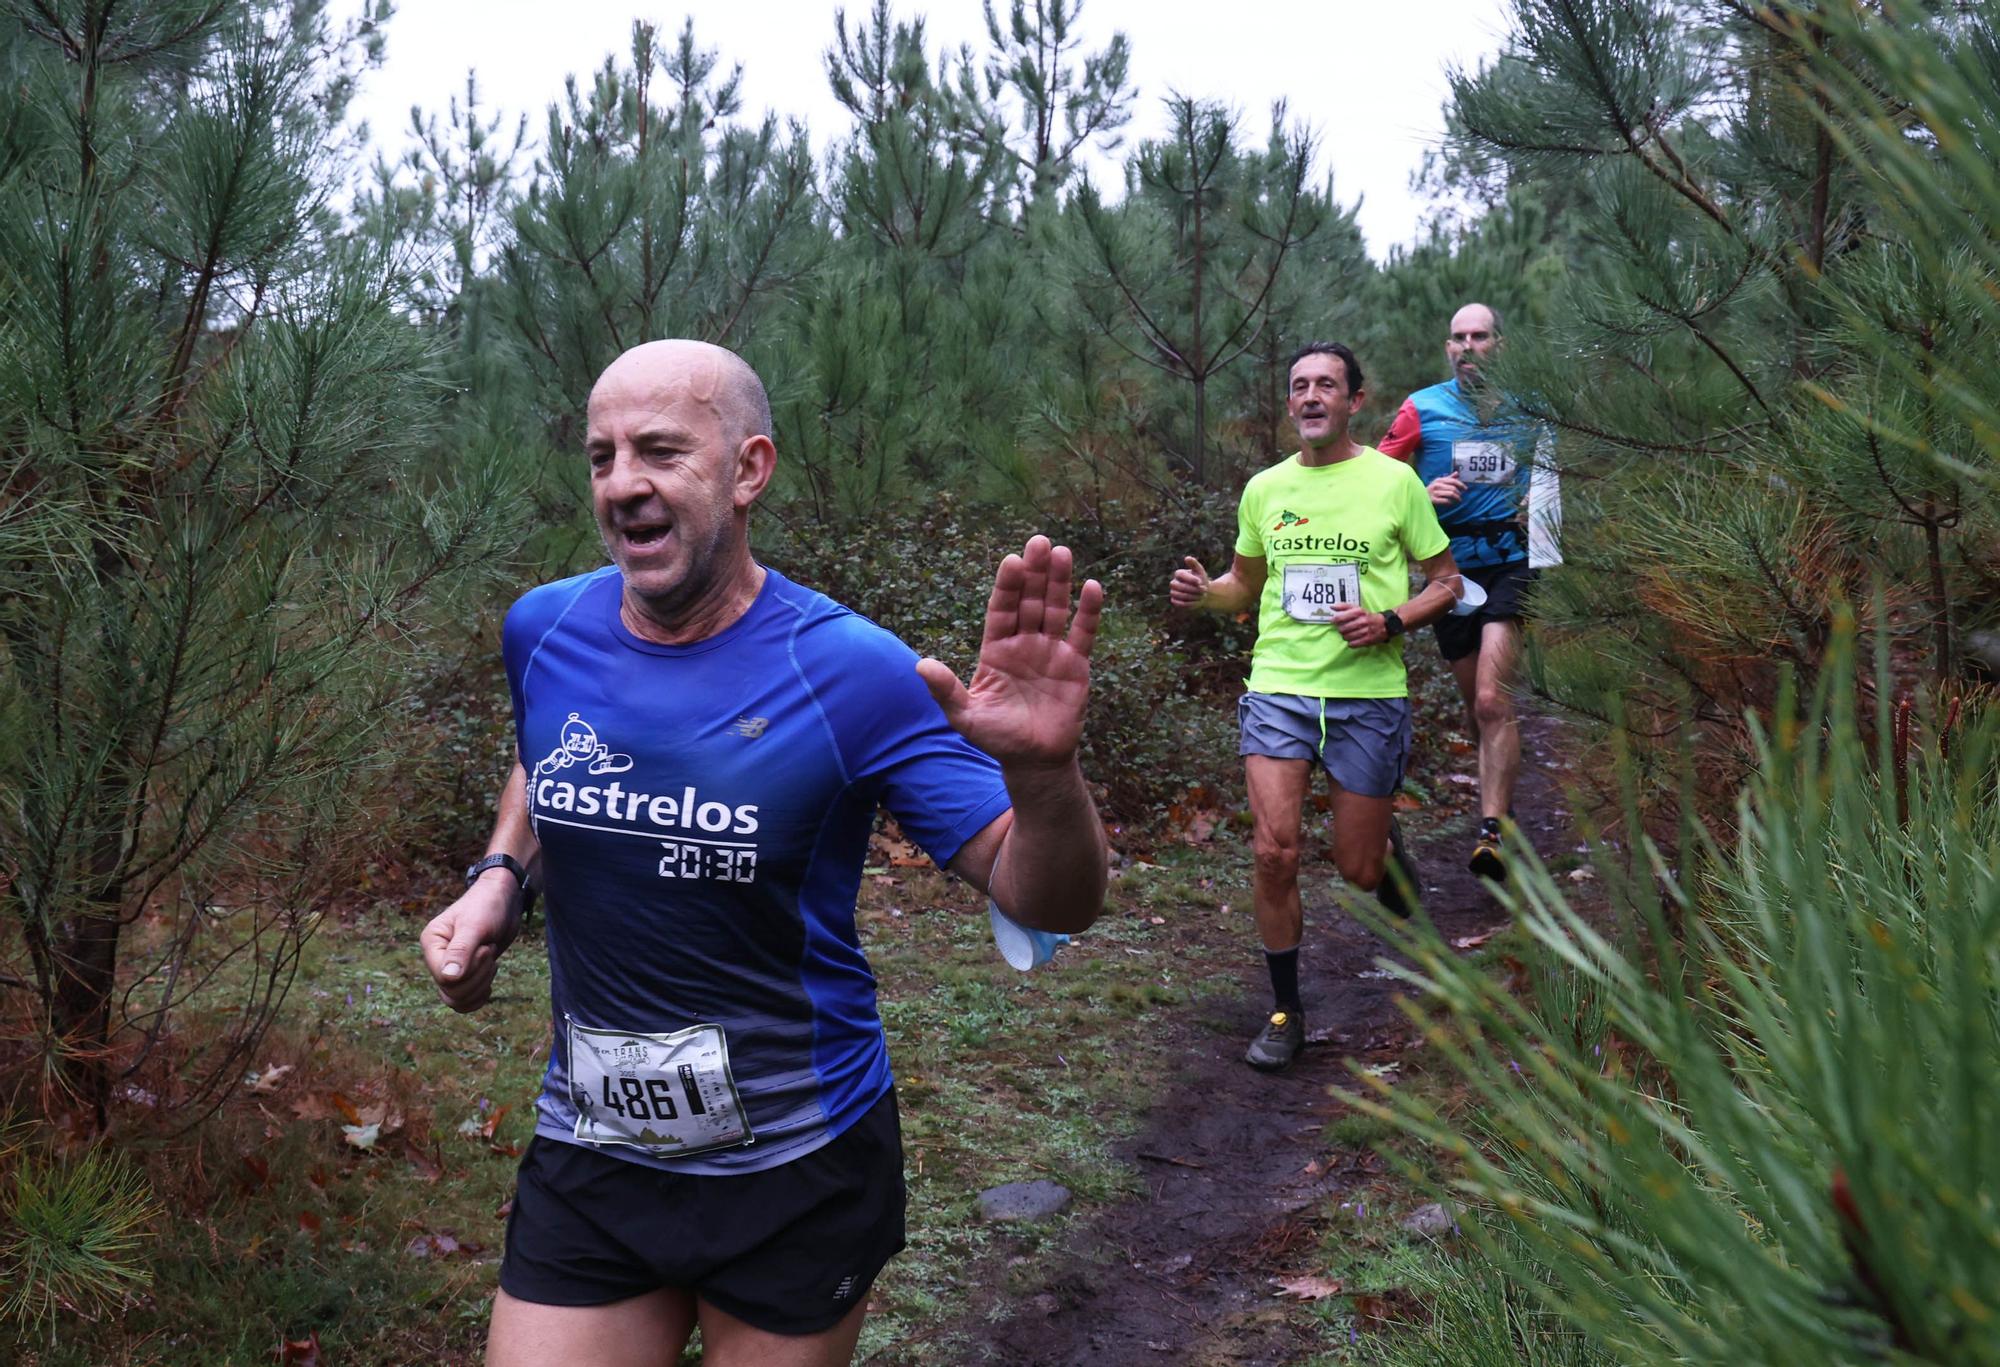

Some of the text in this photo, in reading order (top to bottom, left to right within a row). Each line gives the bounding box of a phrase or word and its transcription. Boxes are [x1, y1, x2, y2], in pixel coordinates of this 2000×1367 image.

[1469, 456, 1497, 472] 539
[1273, 533, 1370, 553] castrelos
[1302, 583, 1336, 604] 488
[536, 778, 759, 834] castrelos
[658, 842, 758, 883] 20:30
[603, 1075, 678, 1120] 486
